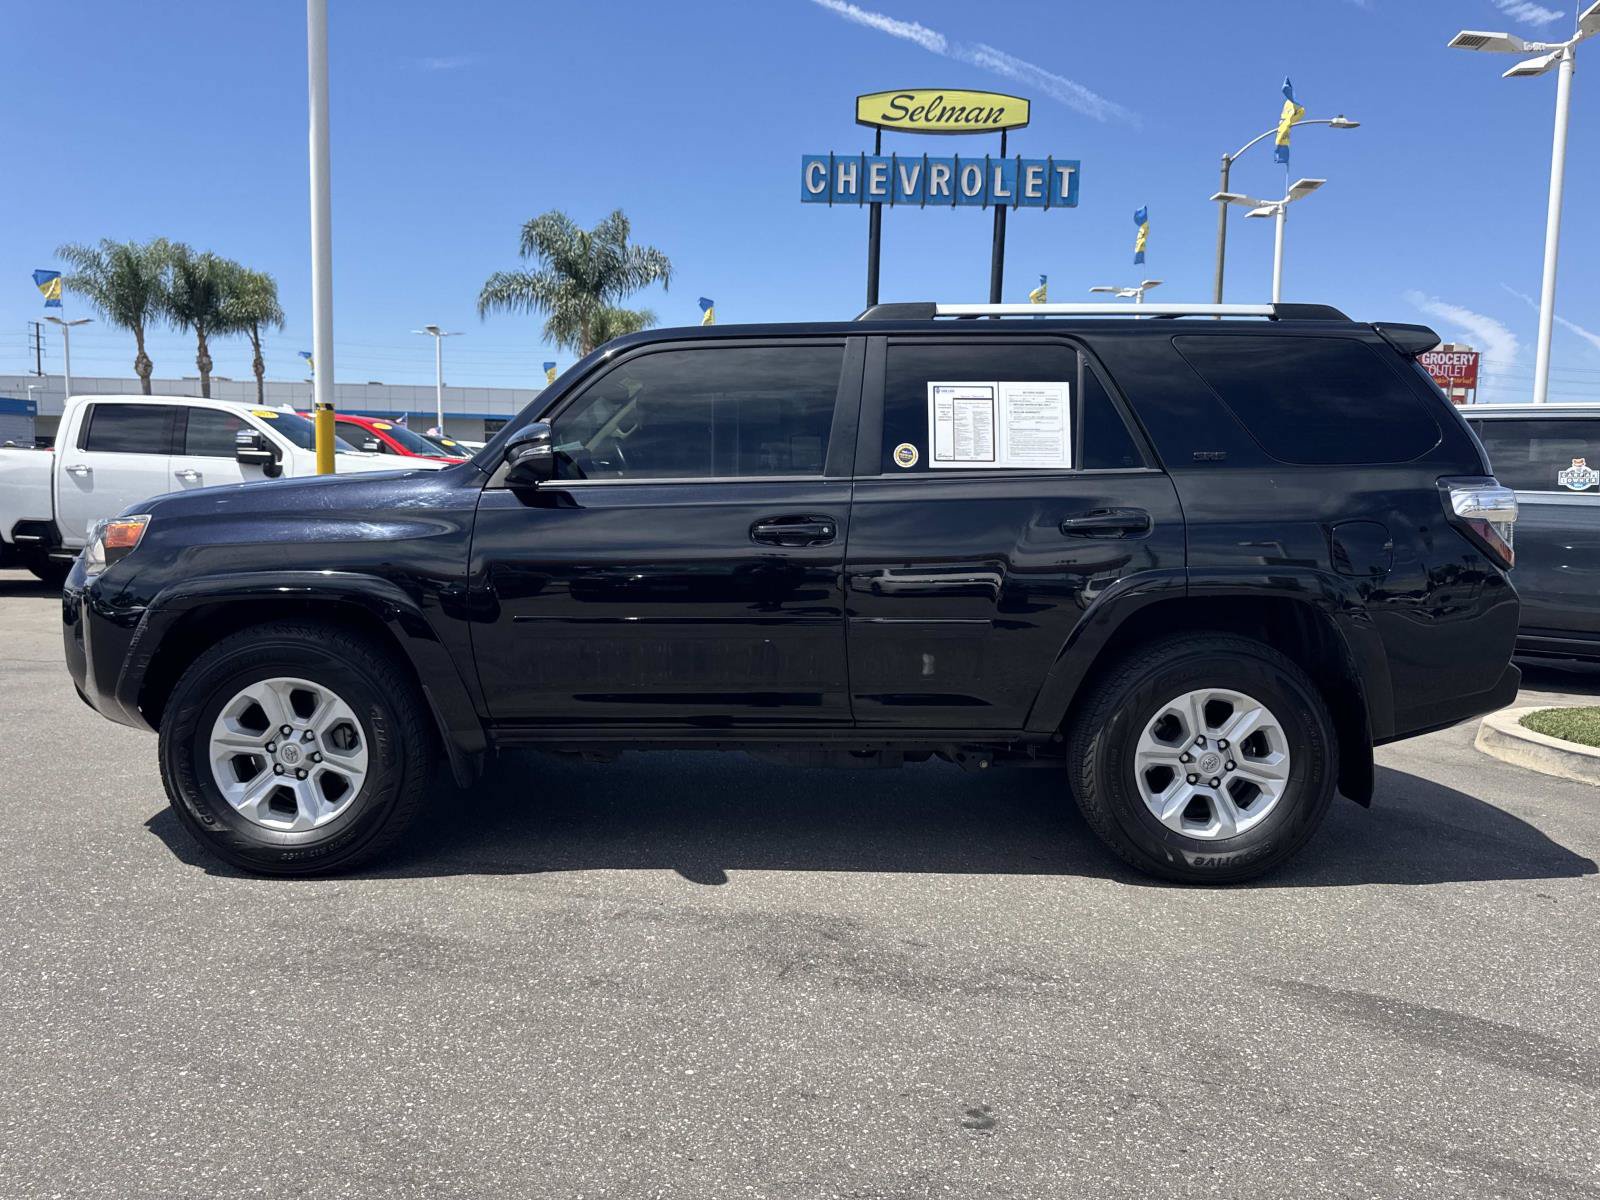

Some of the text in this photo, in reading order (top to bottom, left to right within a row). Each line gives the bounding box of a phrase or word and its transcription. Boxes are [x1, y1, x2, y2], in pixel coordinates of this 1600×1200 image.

[881, 94, 1005, 124] Selman
[805, 160, 1076, 198] CHEVROLET
[1421, 353, 1476, 365] GROCERY
[1429, 364, 1467, 377] OUTLET
